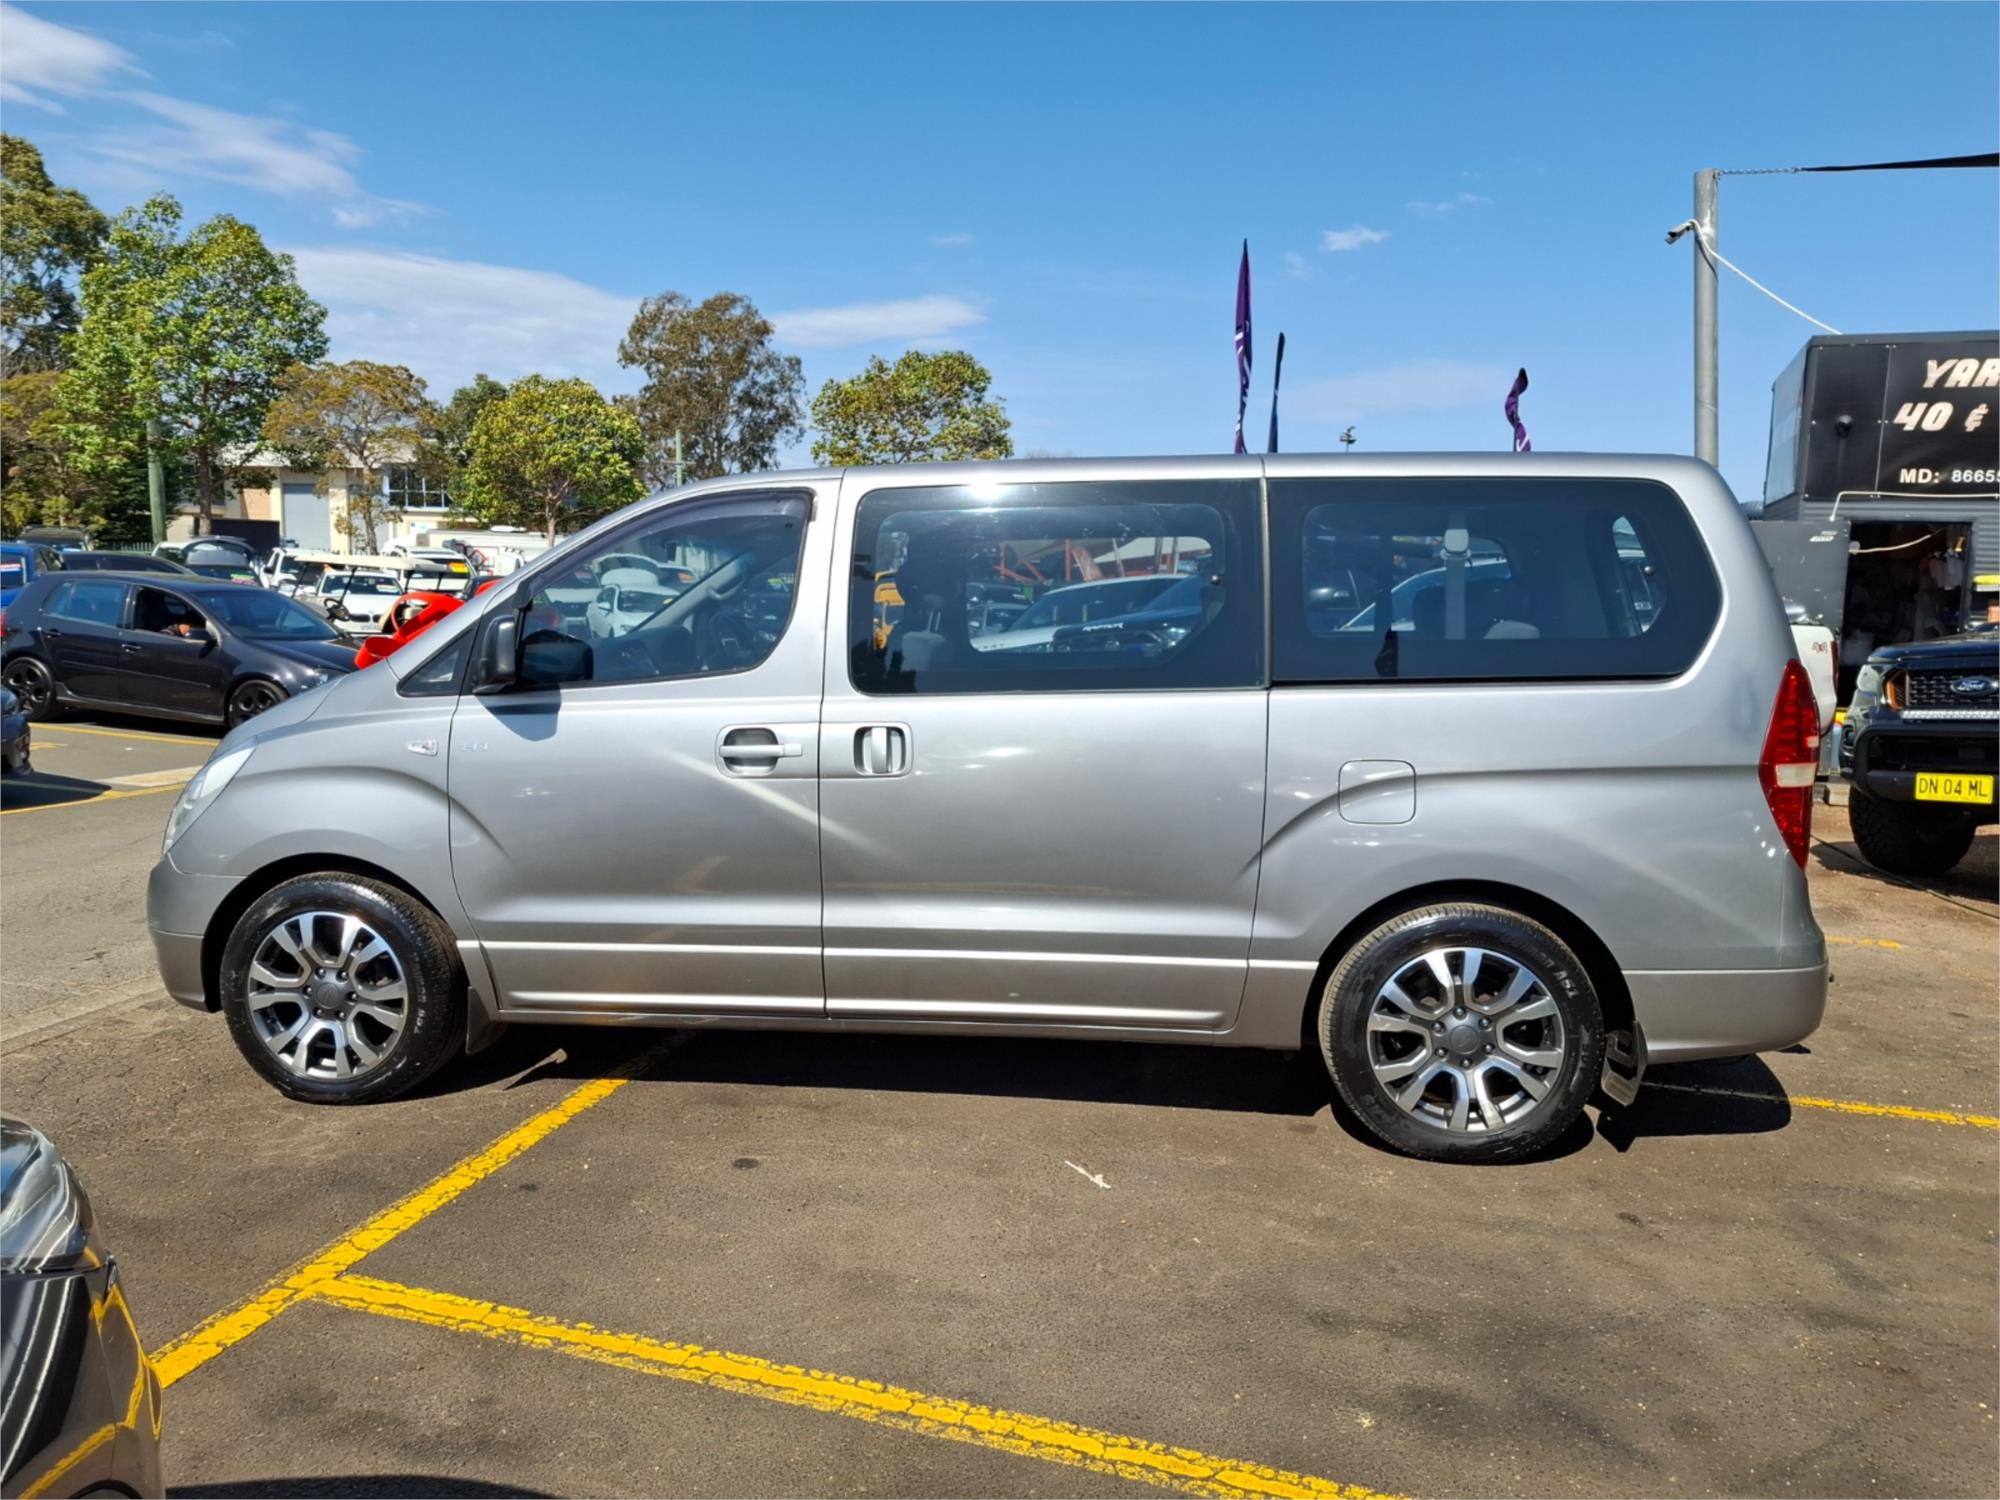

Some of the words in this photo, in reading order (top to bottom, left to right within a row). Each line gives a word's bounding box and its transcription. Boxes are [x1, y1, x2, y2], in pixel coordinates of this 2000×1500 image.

[1893, 401, 1954, 431] 40
[1899, 468, 1940, 484] MD:
[1919, 777, 1938, 794] DN
[1968, 780, 1988, 797] ML
